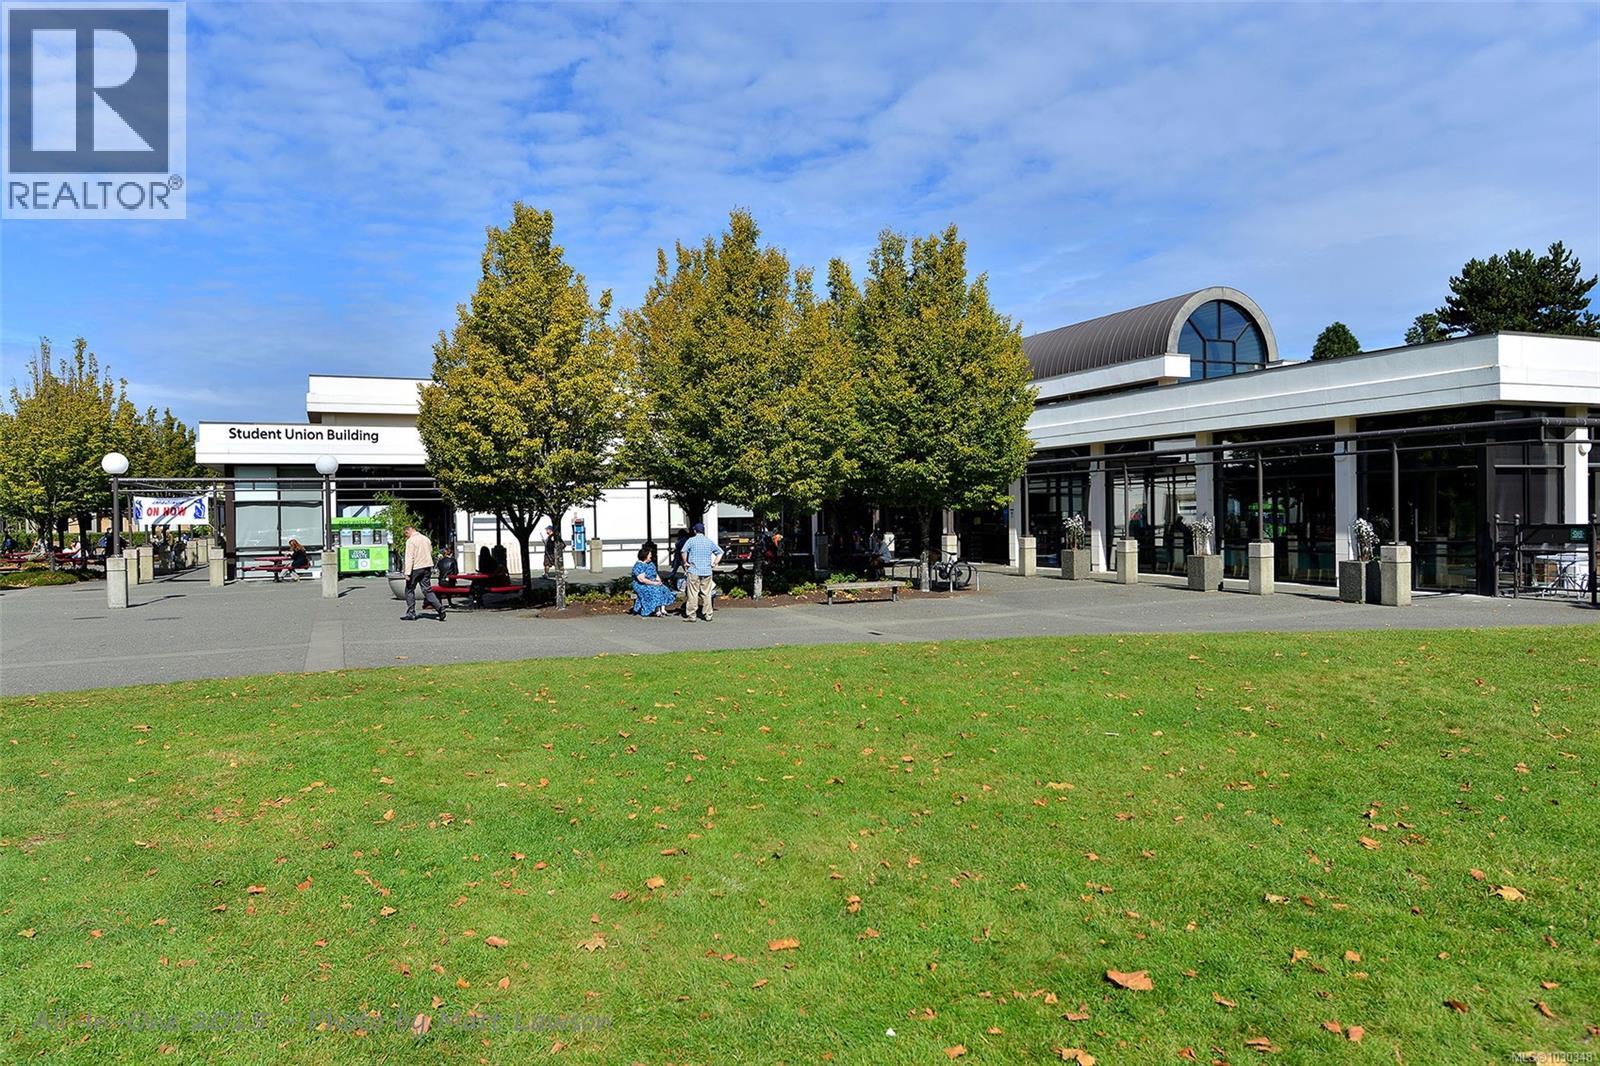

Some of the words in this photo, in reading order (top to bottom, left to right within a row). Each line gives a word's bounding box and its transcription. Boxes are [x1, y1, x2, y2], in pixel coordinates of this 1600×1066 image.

[229, 427, 282, 440] Student
[285, 428, 324, 440] Union
[327, 429, 379, 443] Building
[146, 506, 160, 517] ON
[163, 506, 187, 517] NOW
